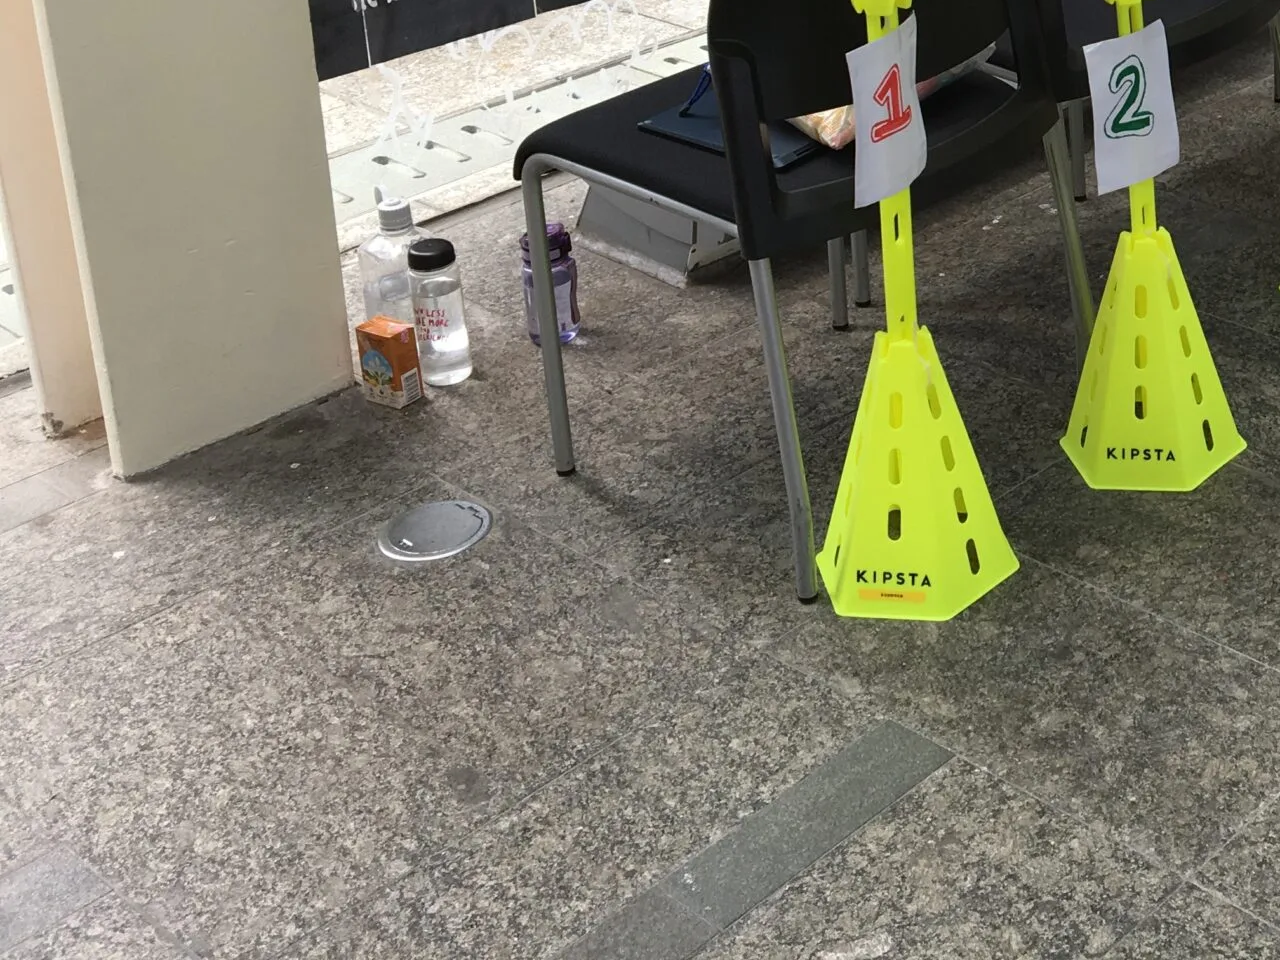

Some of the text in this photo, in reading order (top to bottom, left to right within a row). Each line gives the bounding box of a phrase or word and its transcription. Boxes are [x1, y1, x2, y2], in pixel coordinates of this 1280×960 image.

[870, 63, 912, 144] 1
[1103, 54, 1154, 139] 2
[1106, 446, 1176, 462] KIPSTA
[856, 569, 932, 588] KIPSTA
